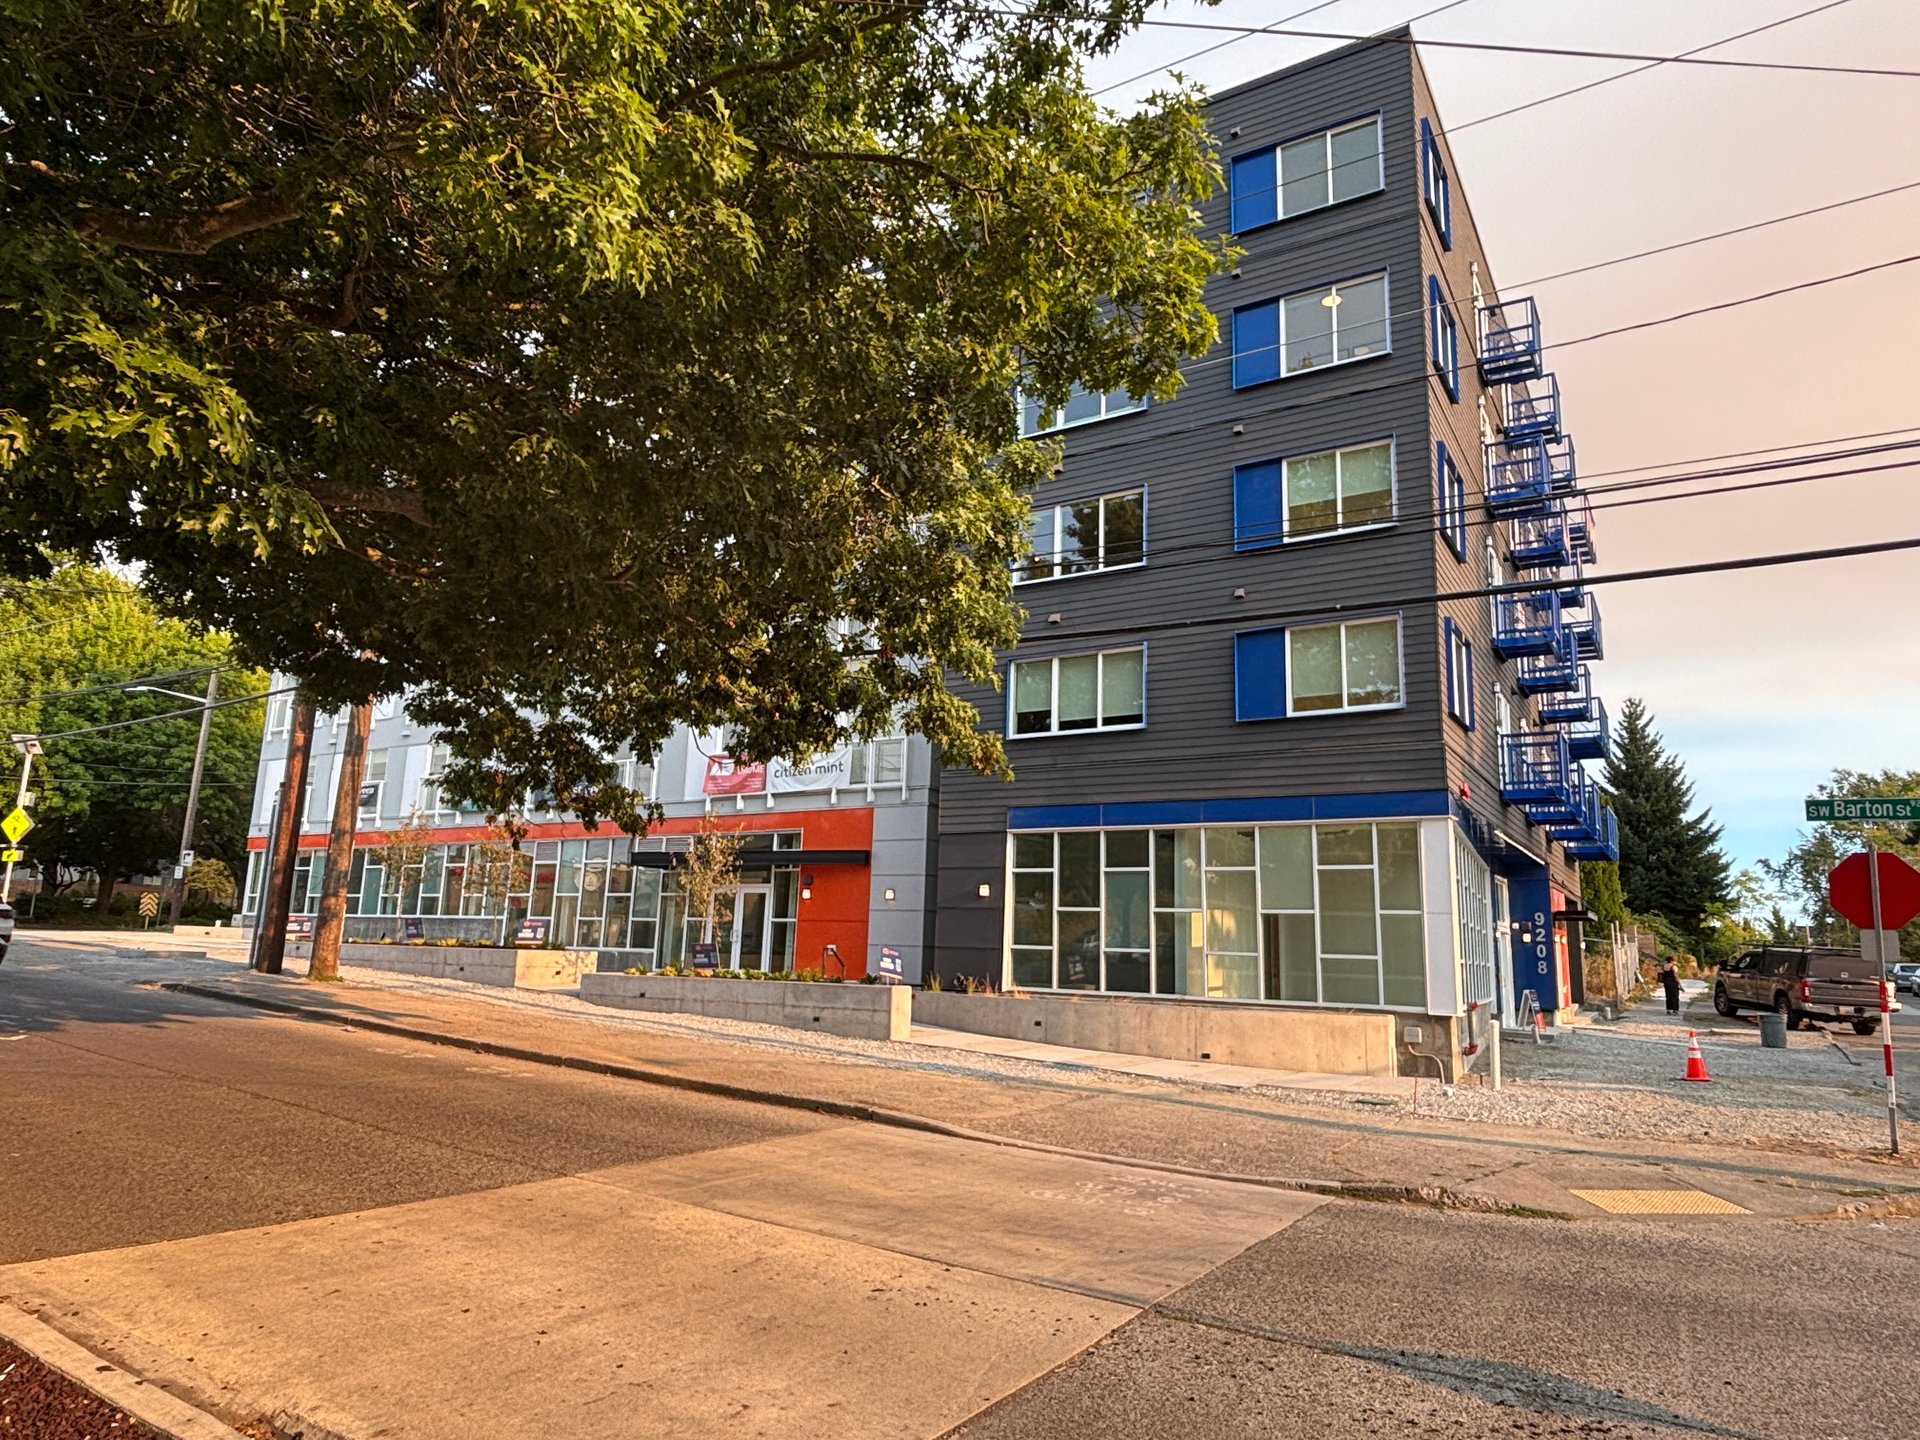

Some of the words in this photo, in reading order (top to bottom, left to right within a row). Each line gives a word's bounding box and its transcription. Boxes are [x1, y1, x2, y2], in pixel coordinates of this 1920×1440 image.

[774, 766, 812, 778] citizen
[815, 762, 844, 774] mint
[1808, 806, 1830, 817] SW
[1834, 800, 1893, 817] Barton
[1896, 803, 1912, 817] St
[1534, 912, 1548, 975] 9208
